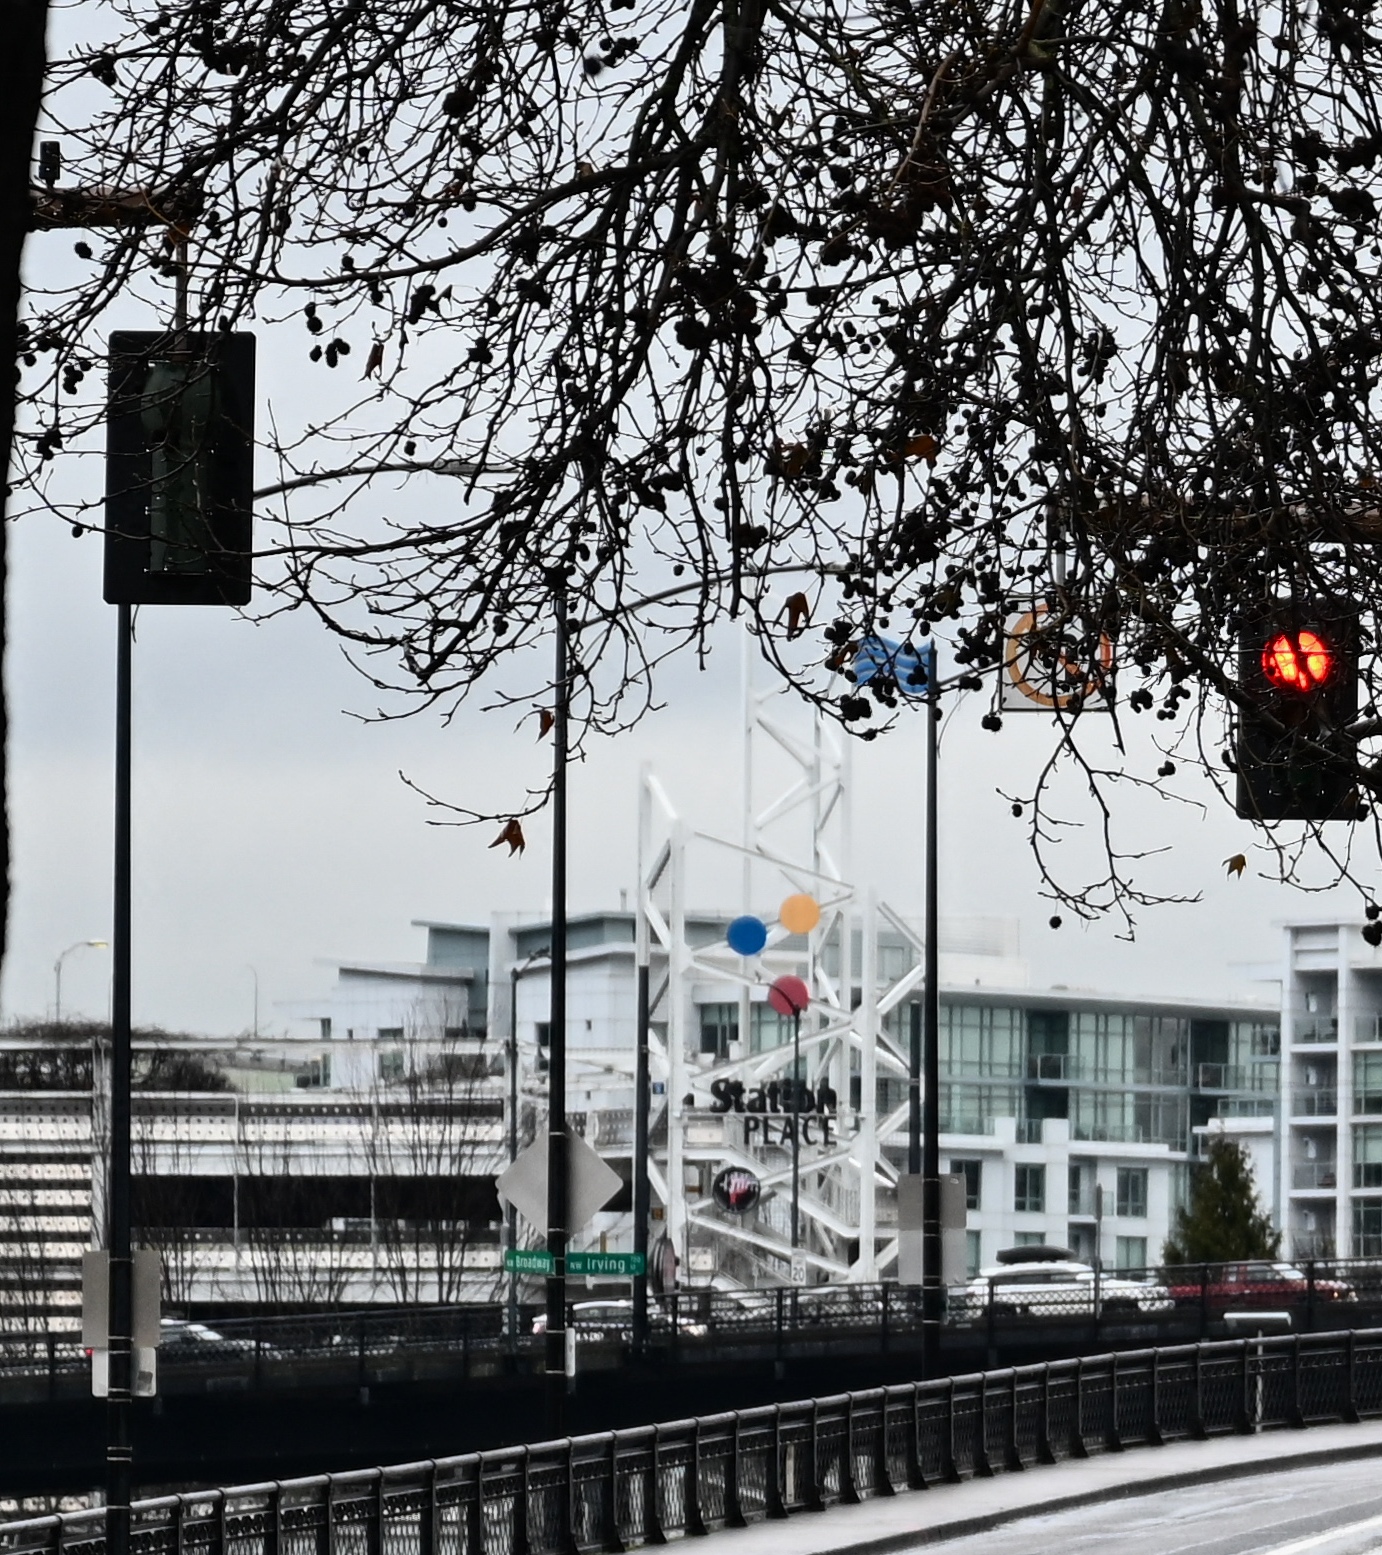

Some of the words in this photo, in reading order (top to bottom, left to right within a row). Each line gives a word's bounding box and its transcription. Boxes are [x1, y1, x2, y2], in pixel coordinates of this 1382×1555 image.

[710, 1078, 837, 1113] Station
[744, 1117, 837, 1145] PLACE
[515, 1255, 550, 1271] Broadway
[570, 1262, 583, 1271] NW
[587, 1257, 626, 1274] Irving
